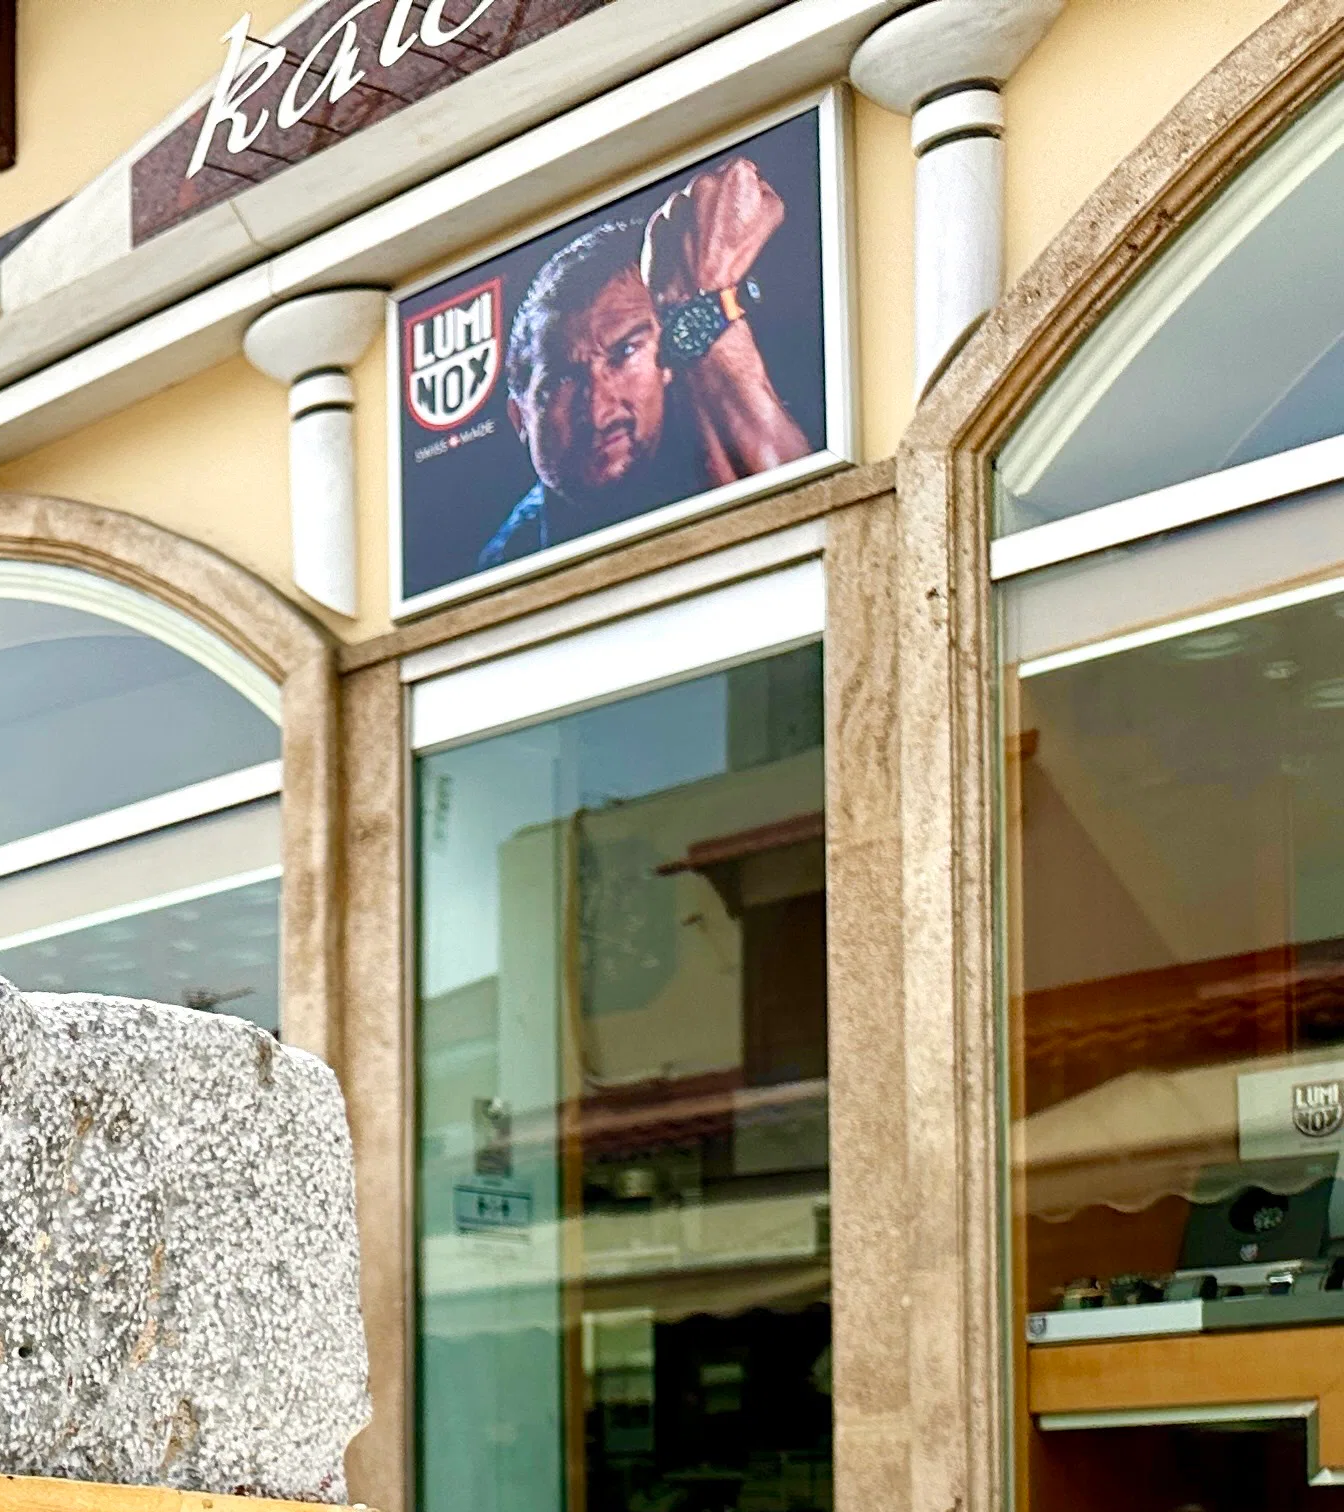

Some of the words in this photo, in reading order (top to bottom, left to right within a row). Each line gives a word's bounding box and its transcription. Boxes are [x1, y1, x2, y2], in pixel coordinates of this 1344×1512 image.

[413, 291, 492, 370] LUMI
[417, 348, 490, 416] NOX
[1296, 1083, 1339, 1109] LUMI
